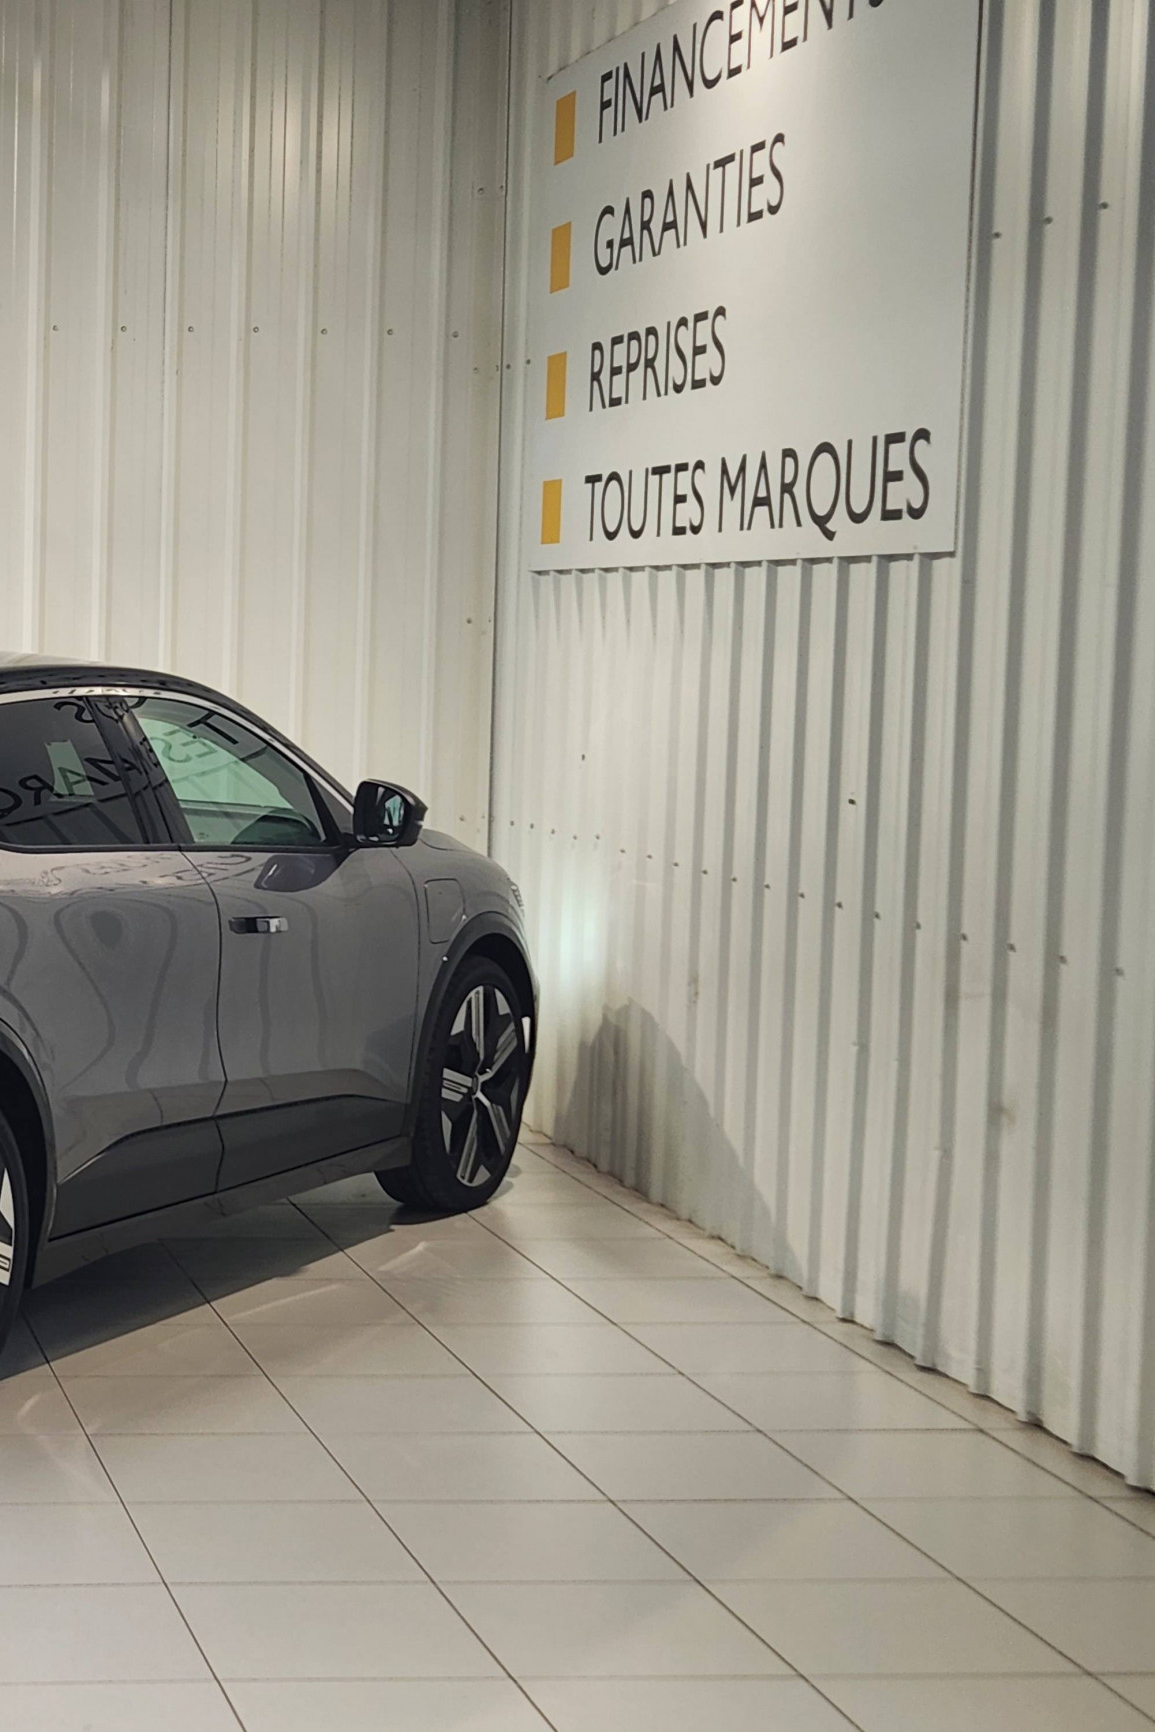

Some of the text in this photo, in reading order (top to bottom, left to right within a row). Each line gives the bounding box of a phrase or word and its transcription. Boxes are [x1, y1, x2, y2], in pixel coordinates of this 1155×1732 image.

[598, 0, 884, 144] FINANCEMEN
[593, 132, 786, 276] GARANTIES
[588, 305, 727, 413] REPRISES
[584, 427, 932, 543] TOUTES MARQUES
